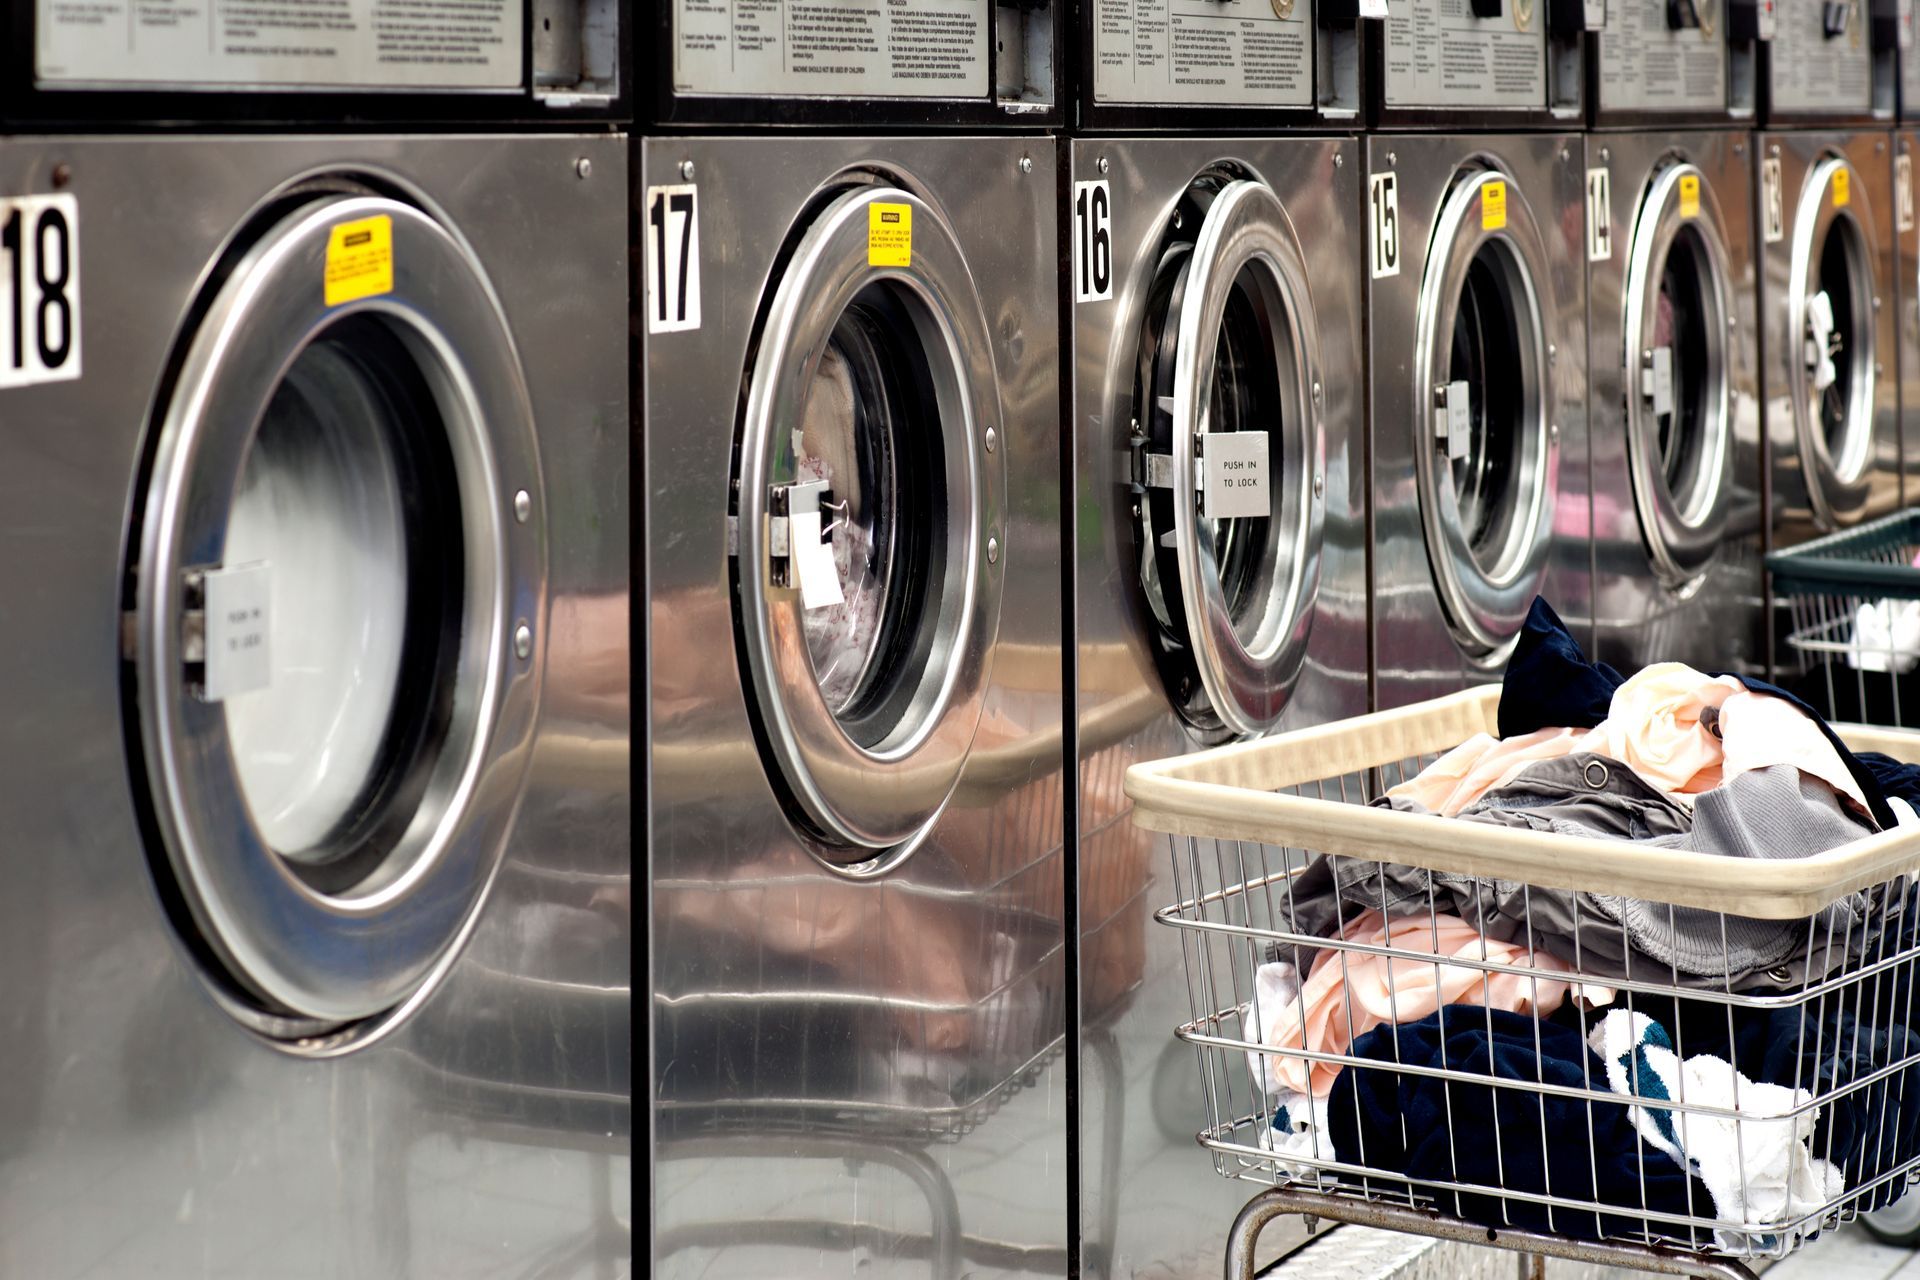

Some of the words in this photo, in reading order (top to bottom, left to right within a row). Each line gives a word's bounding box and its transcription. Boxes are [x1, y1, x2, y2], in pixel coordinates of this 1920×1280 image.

[651, 193, 693, 322] 17
[1077, 186, 1110, 295] 16
[1373, 178, 1396, 270] 15
[1590, 175, 1607, 254] 14
[2, 207, 71, 369] 18
[1224, 461, 1244, 470] PUSH
[1248, 461, 1257, 469] IN
[1224, 479, 1233, 488] TO
[1238, 478, 1258, 487] LOCK
